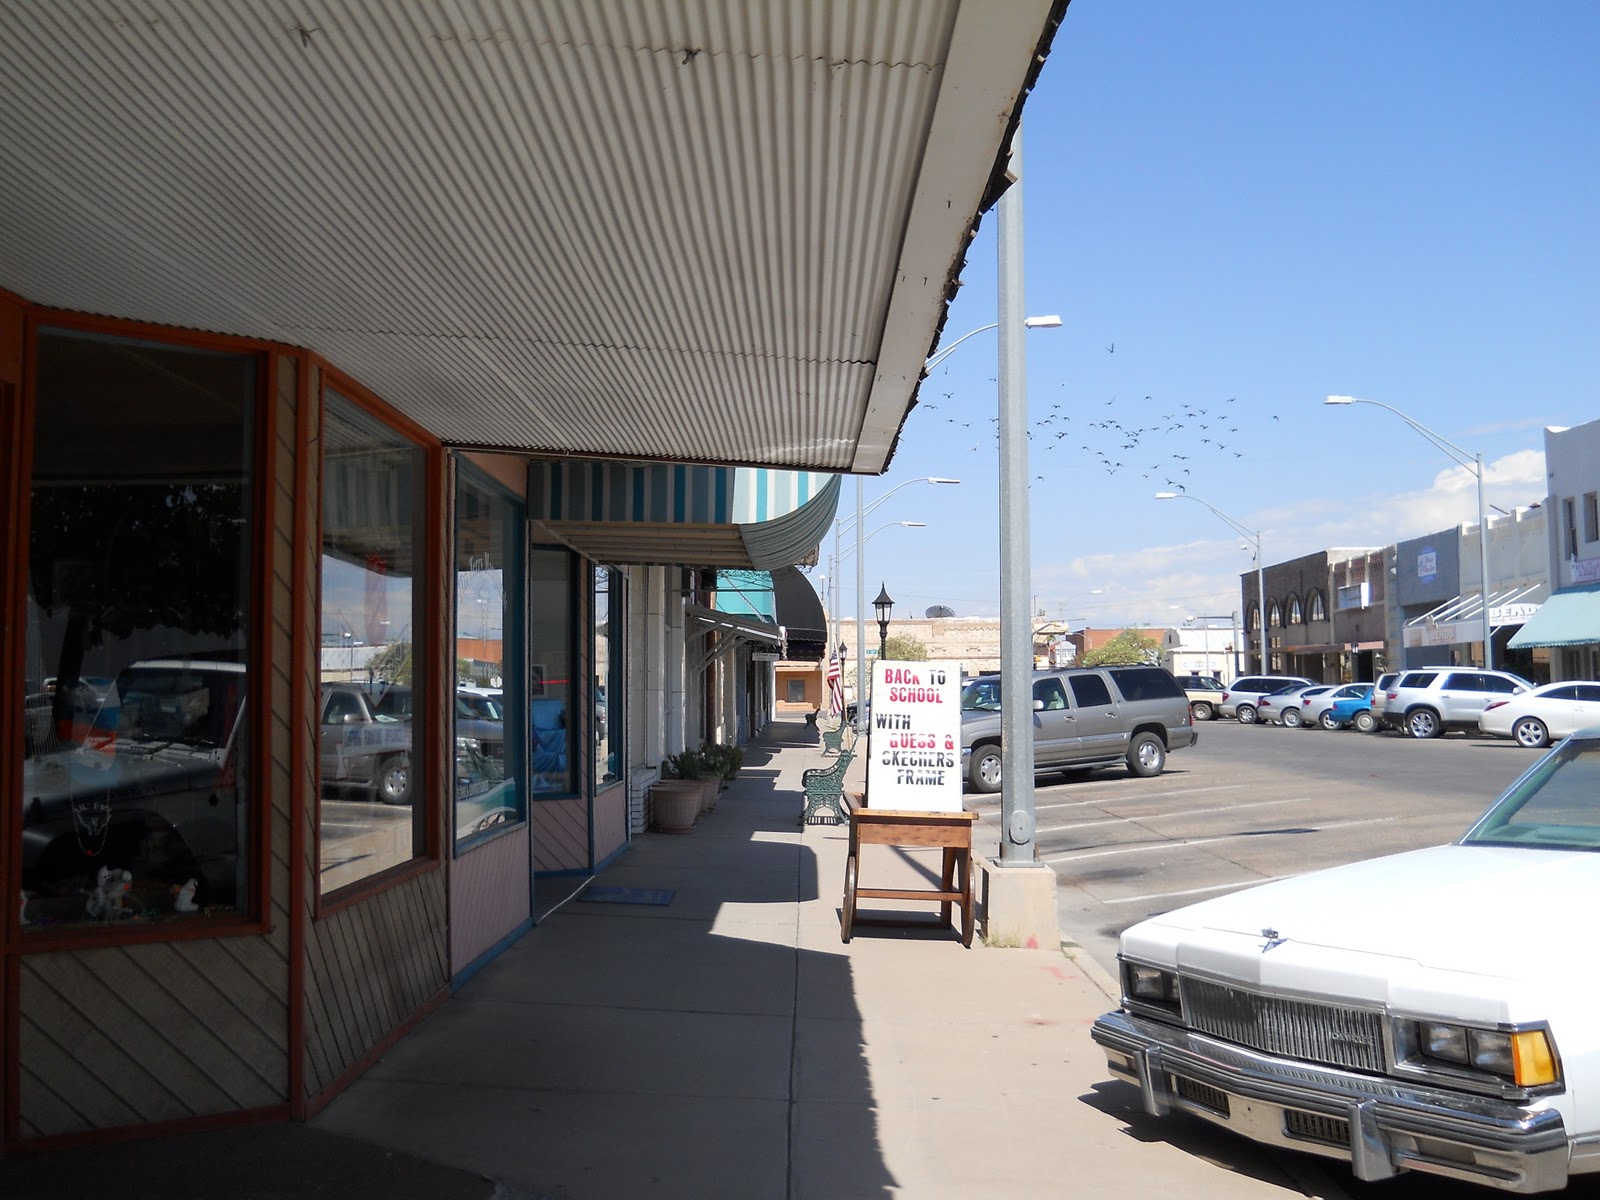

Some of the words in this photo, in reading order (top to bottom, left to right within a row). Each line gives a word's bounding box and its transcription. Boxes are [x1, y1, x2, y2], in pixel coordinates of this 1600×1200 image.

[1490, 605, 1538, 619] BEAD
[884, 668, 920, 685] BACK
[929, 669, 946, 685] TO
[889, 686, 943, 704] SCHOOL
[876, 713, 911, 730] WITH
[889, 732, 936, 749] GUESS
[882, 750, 955, 768] SKECHERS
[896, 768, 946, 786] FRAME
